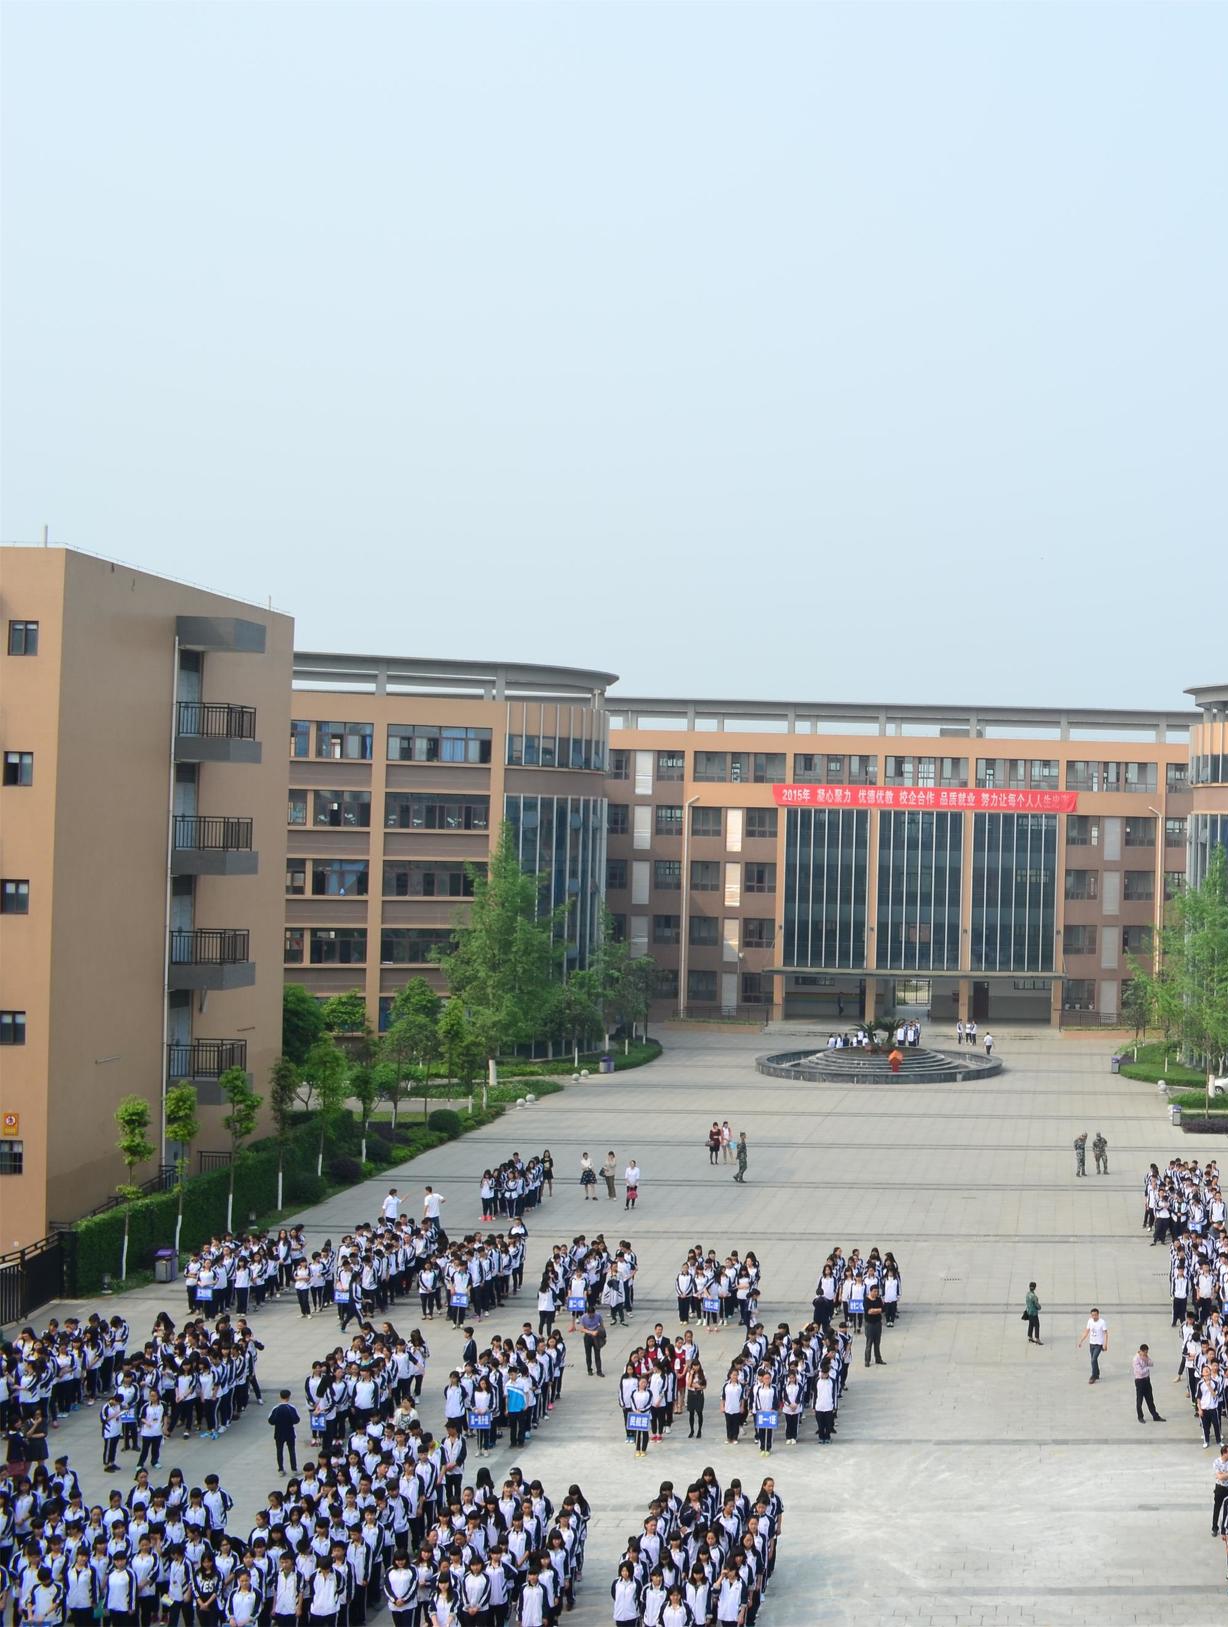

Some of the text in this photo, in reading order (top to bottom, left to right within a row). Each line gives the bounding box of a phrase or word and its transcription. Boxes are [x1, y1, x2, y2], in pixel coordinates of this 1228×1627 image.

[782, 789, 811, 803] 2015年
[816, 789, 851, 804] 凝心聚力
[899, 790, 935, 806] 校企合作
[939, 791, 976, 807] 品质就业
[199, 1579, 214, 1593] YES
